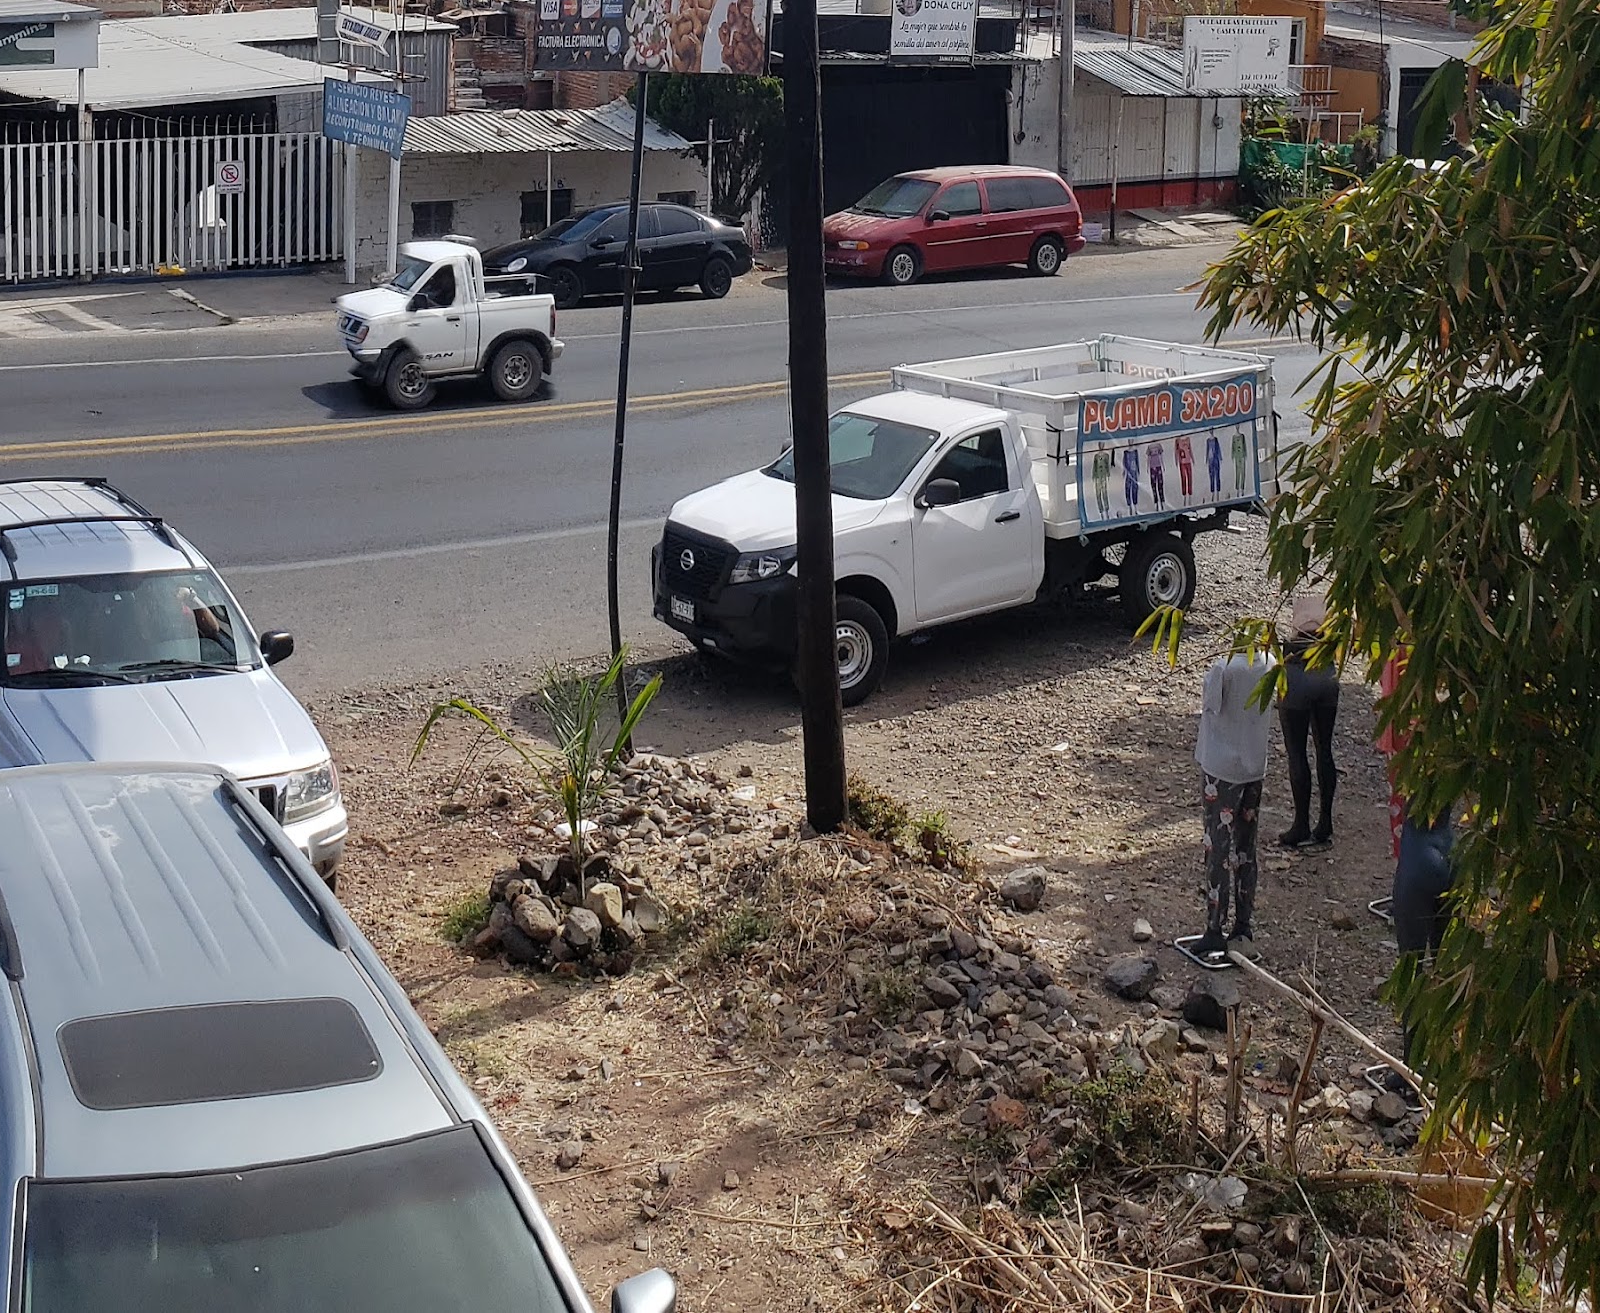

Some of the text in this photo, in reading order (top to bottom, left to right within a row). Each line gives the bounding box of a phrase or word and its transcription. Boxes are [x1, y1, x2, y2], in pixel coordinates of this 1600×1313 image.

[543, 1, 558, 13] VISA
[951, 1, 974, 10] CHUY
[538, 35, 564, 48] FACTURA
[369, 87, 395, 104] REYES
[1083, 381, 1254, 434] PIJAMA 3X200
